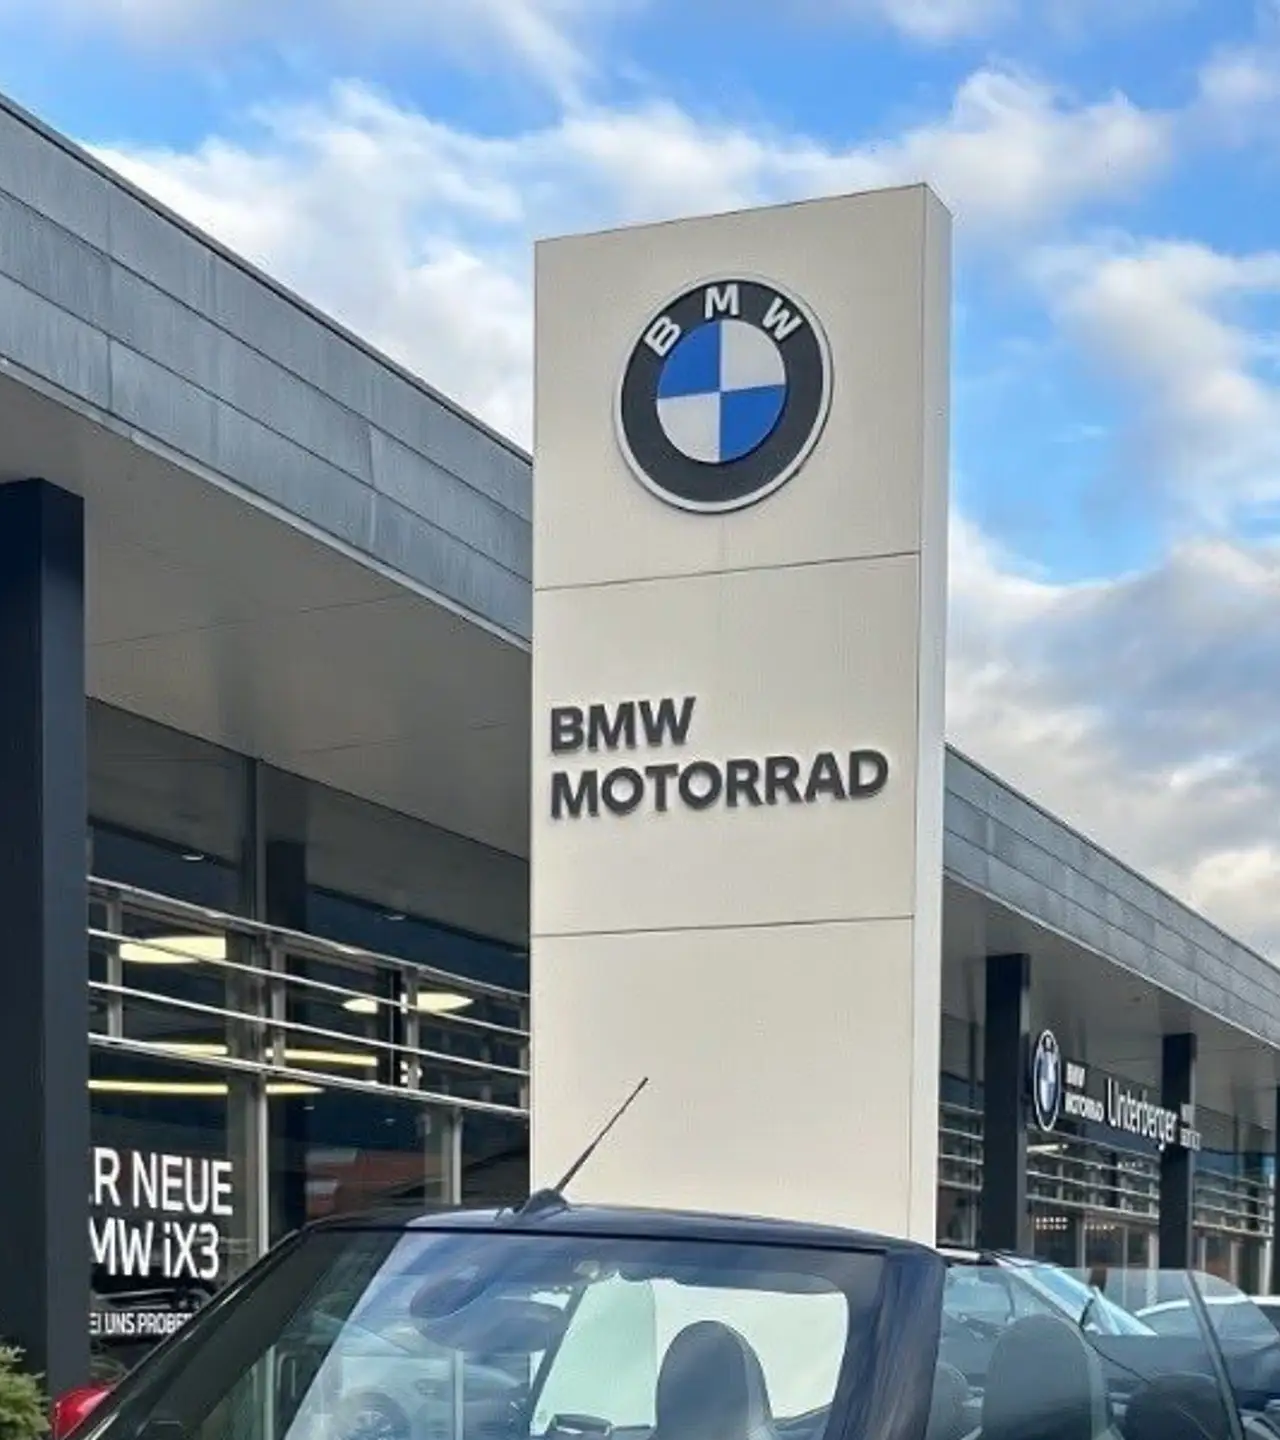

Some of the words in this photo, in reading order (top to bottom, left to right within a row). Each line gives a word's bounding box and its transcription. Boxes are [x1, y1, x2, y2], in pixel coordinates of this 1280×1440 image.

[643, 282, 803, 358] BMW
[550, 697, 696, 755] BMW
[550, 749, 889, 820] MOTORRAD
[89, 1146, 122, 1207] R
[132, 1150, 234, 1216] NEUE
[162, 1221, 220, 1280] iX3
[104, 1312, 135, 1335] UNS
[136, 1313, 193, 1334] PROBE
